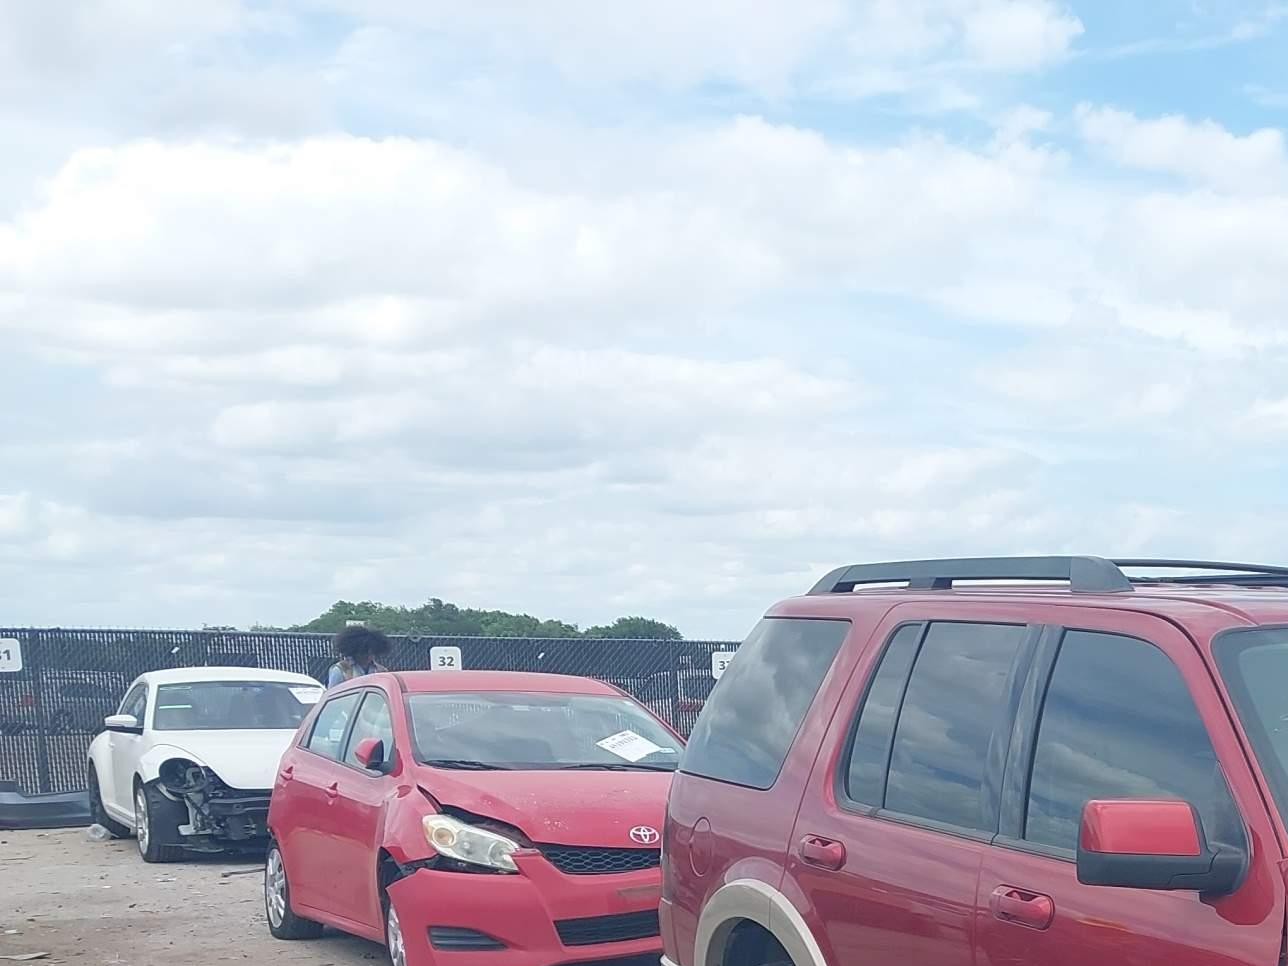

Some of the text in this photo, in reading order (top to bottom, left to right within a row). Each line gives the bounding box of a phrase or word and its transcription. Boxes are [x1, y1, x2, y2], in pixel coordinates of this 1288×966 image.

[0, 649, 11, 661] 1
[438, 656, 455, 667] 32
[719, 660, 730, 671] 3
